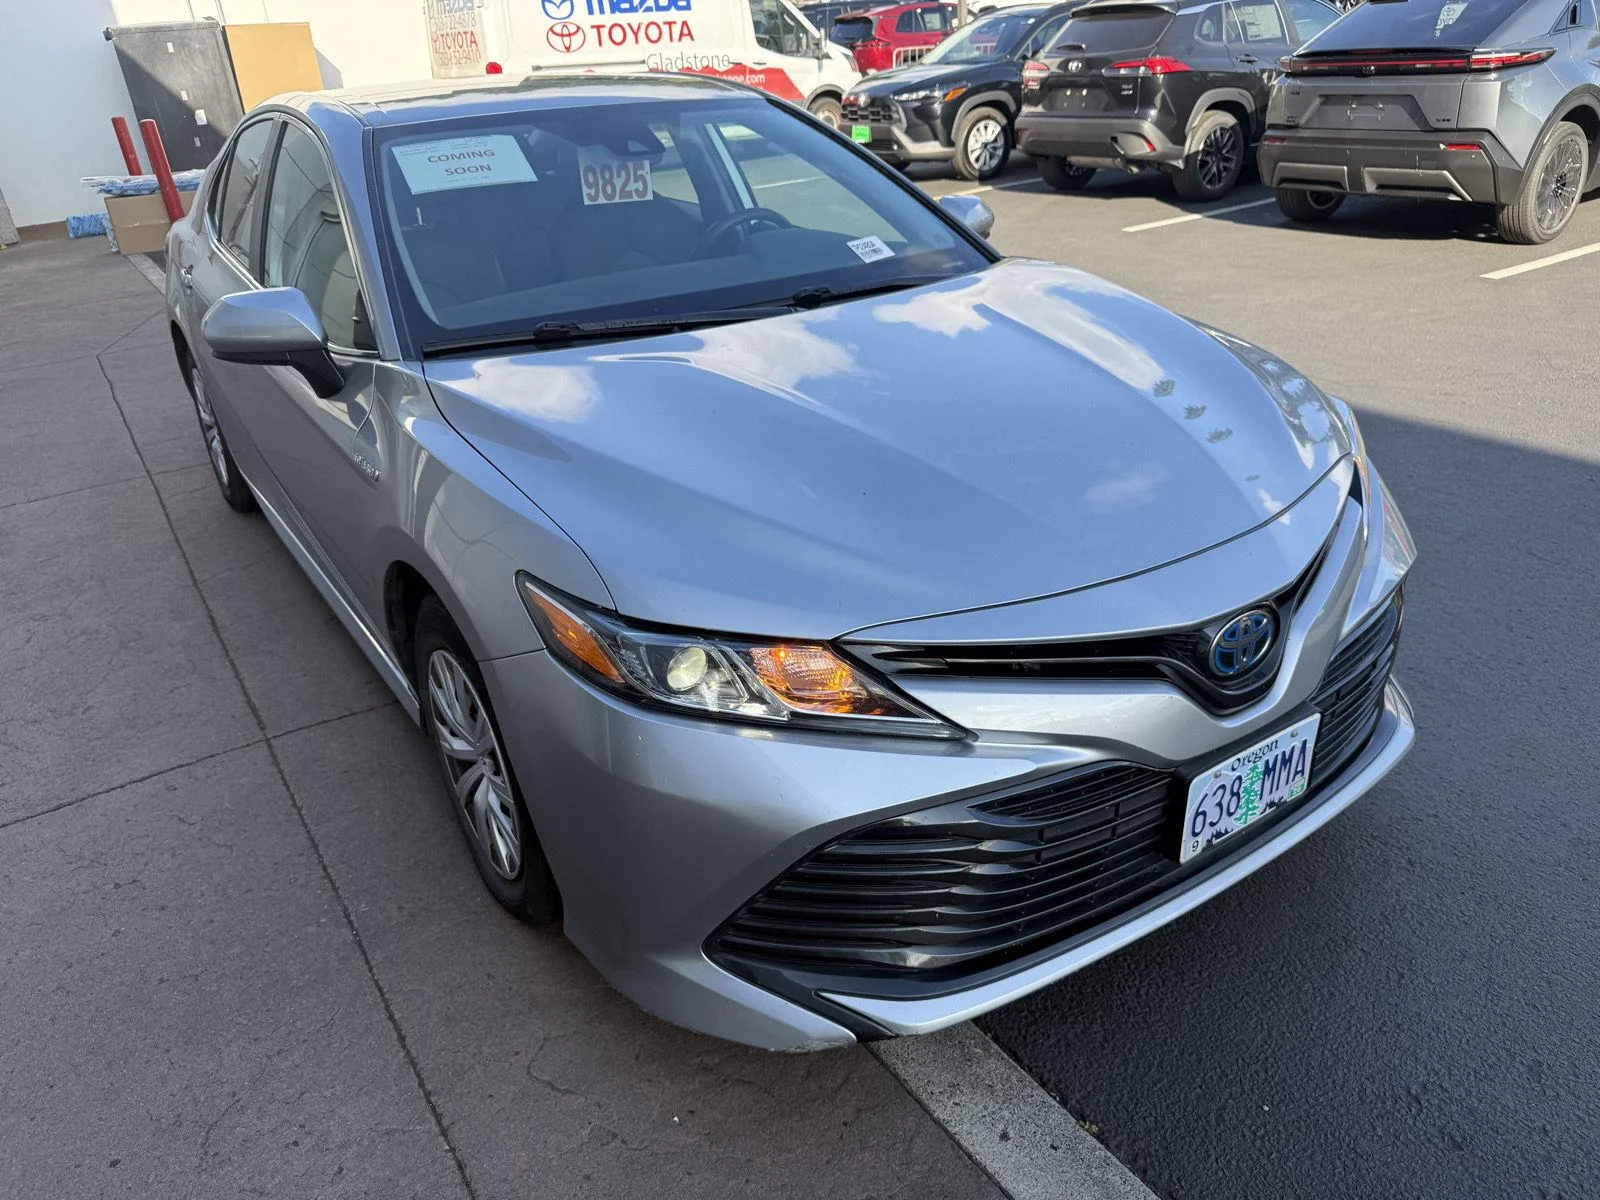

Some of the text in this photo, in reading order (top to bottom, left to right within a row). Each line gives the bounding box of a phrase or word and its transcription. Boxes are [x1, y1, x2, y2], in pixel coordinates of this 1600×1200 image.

[440, 31, 478, 50] TOYOTA
[590, 20, 695, 47] TOYOTA
[646, 52, 730, 72] Gladstone
[427, 149, 495, 163] COMING
[444, 164, 492, 176] SOON
[582, 161, 649, 203] 9825
[1231, 740, 1278, 772] Oregon
[1191, 739, 1308, 838] 638 MMA
